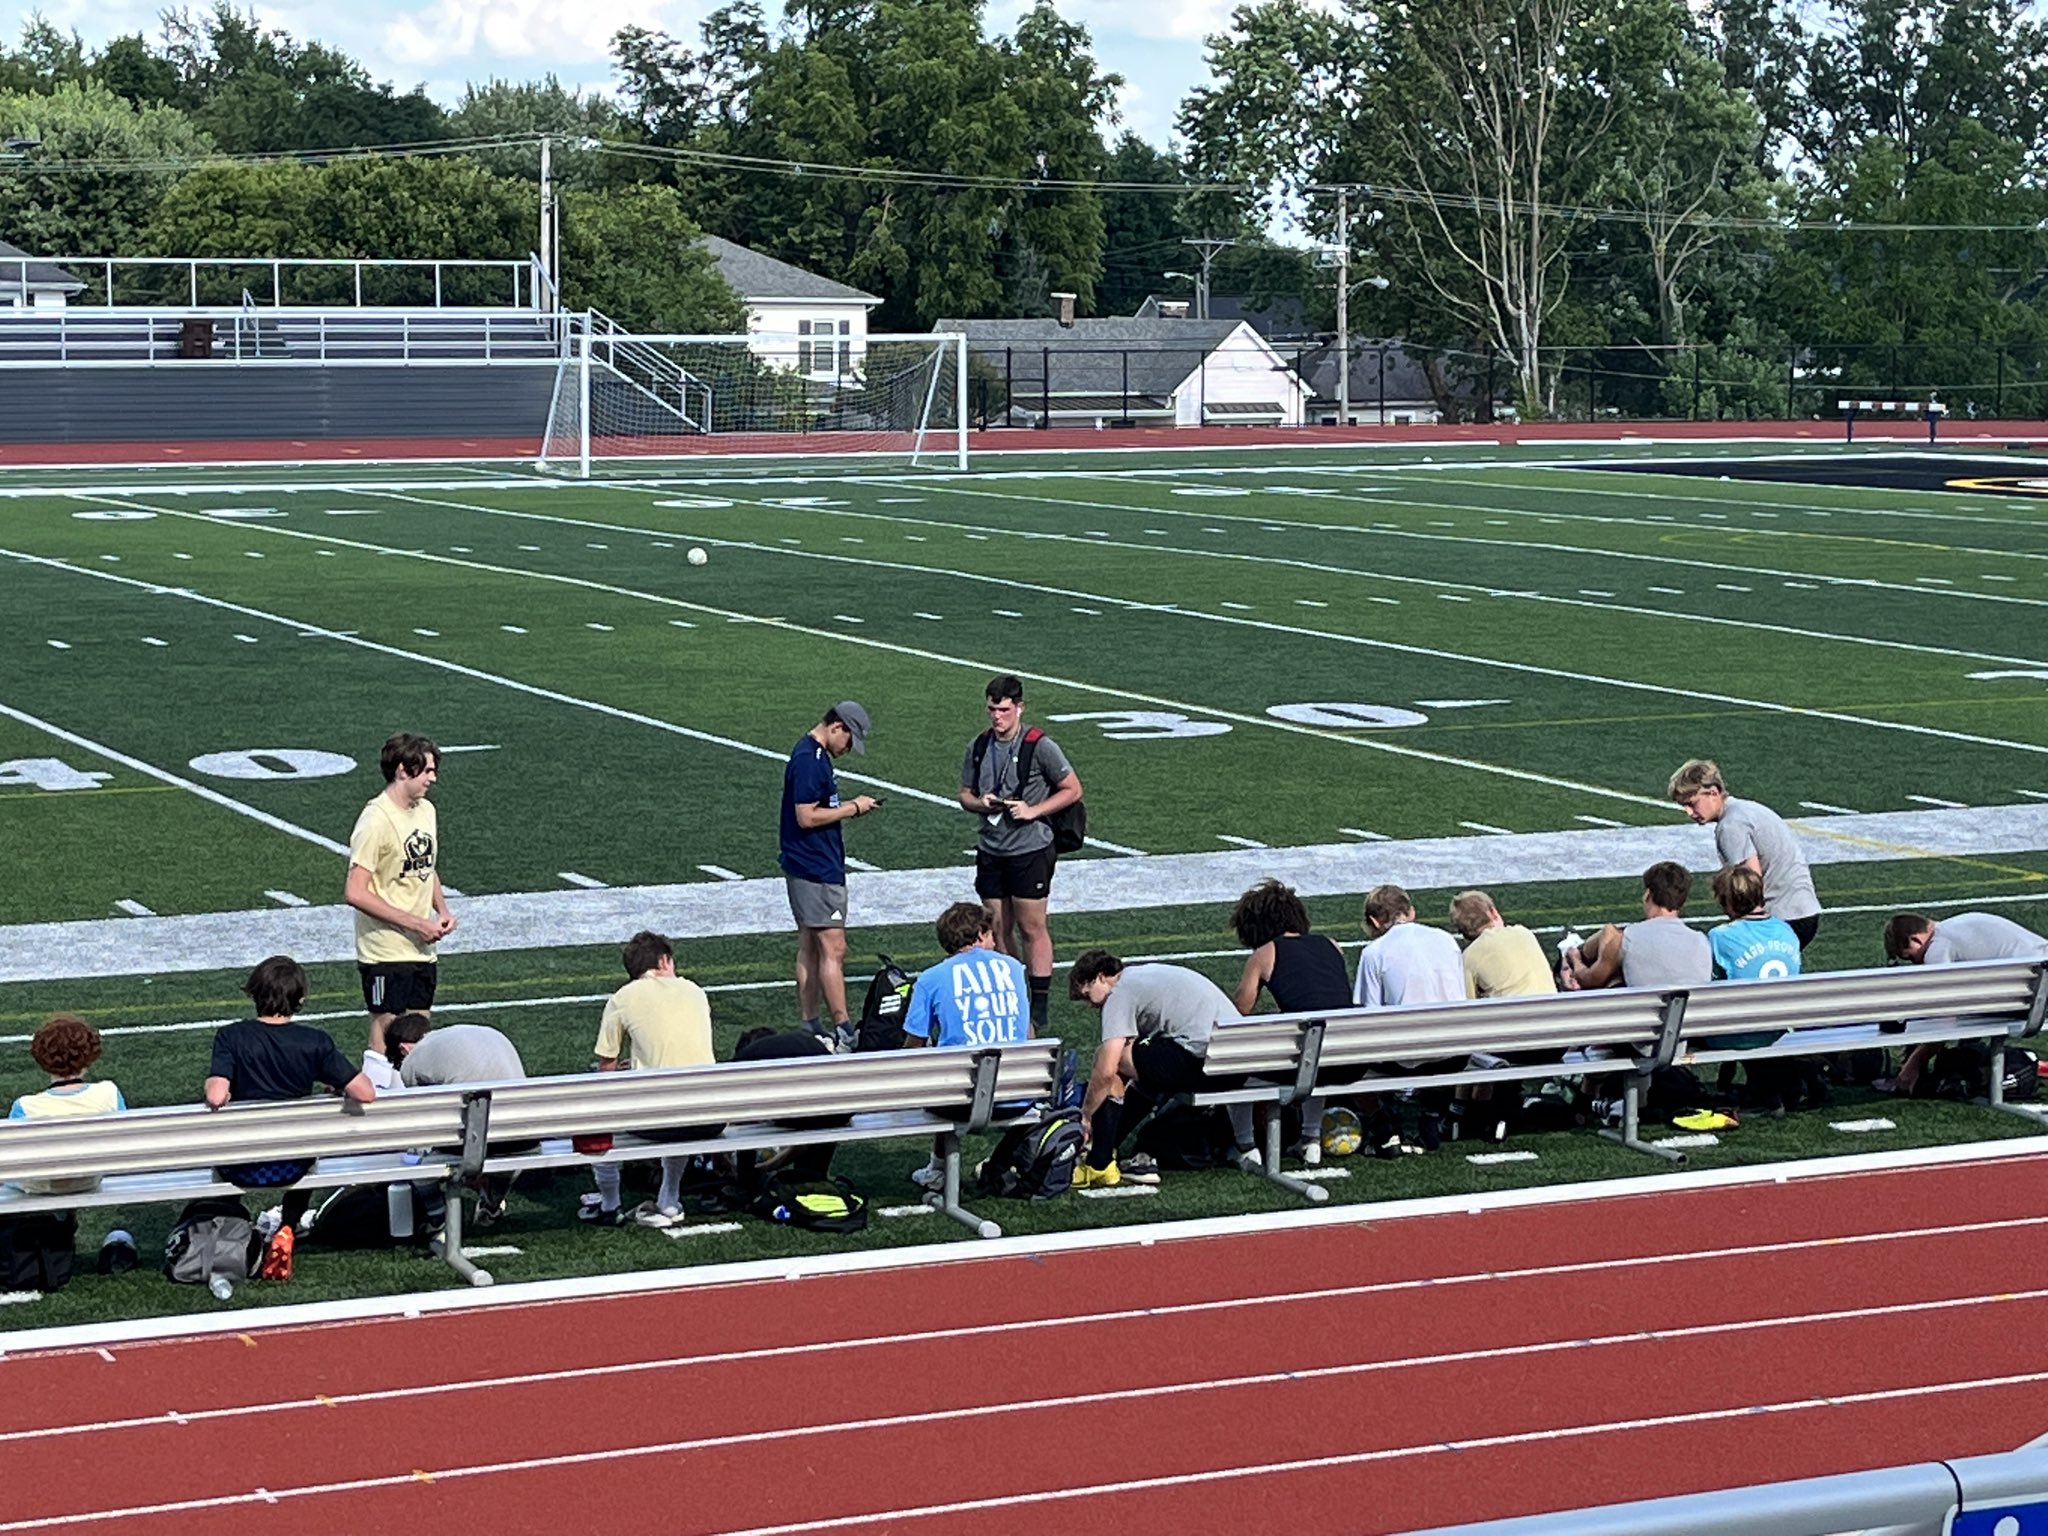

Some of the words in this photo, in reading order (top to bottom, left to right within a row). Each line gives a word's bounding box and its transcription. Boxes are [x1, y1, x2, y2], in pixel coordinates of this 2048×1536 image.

[952, 958, 1016, 997] AIR
[954, 991, 1020, 1022] YOUR
[963, 1016, 1018, 1046] SOLE
